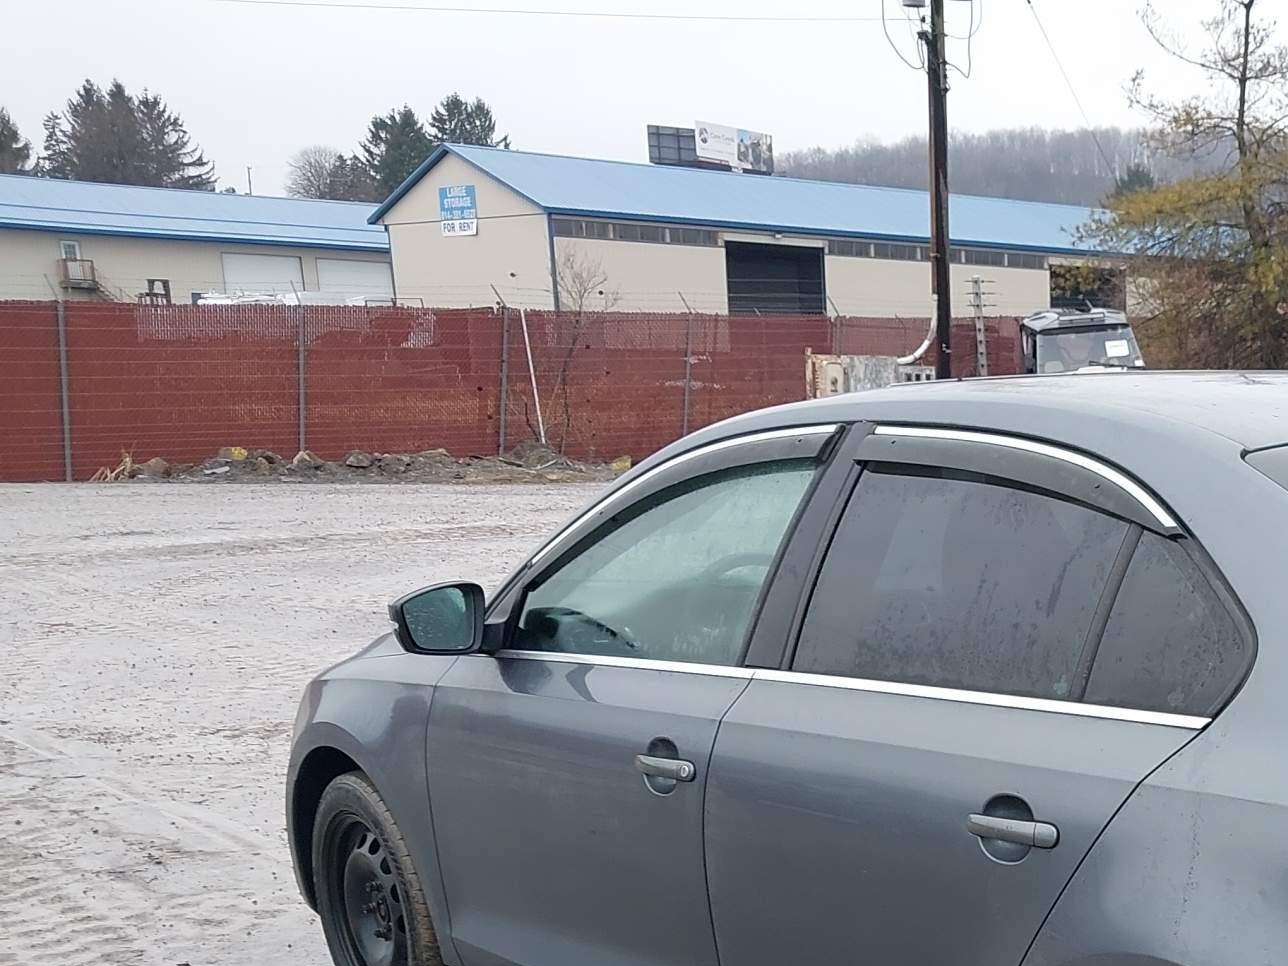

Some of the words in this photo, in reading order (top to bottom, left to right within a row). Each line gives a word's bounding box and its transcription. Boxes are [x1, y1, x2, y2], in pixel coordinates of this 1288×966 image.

[444, 197, 473, 208] STORAGE
[443, 222, 456, 233] FOR
[458, 221, 474, 232] RENT
